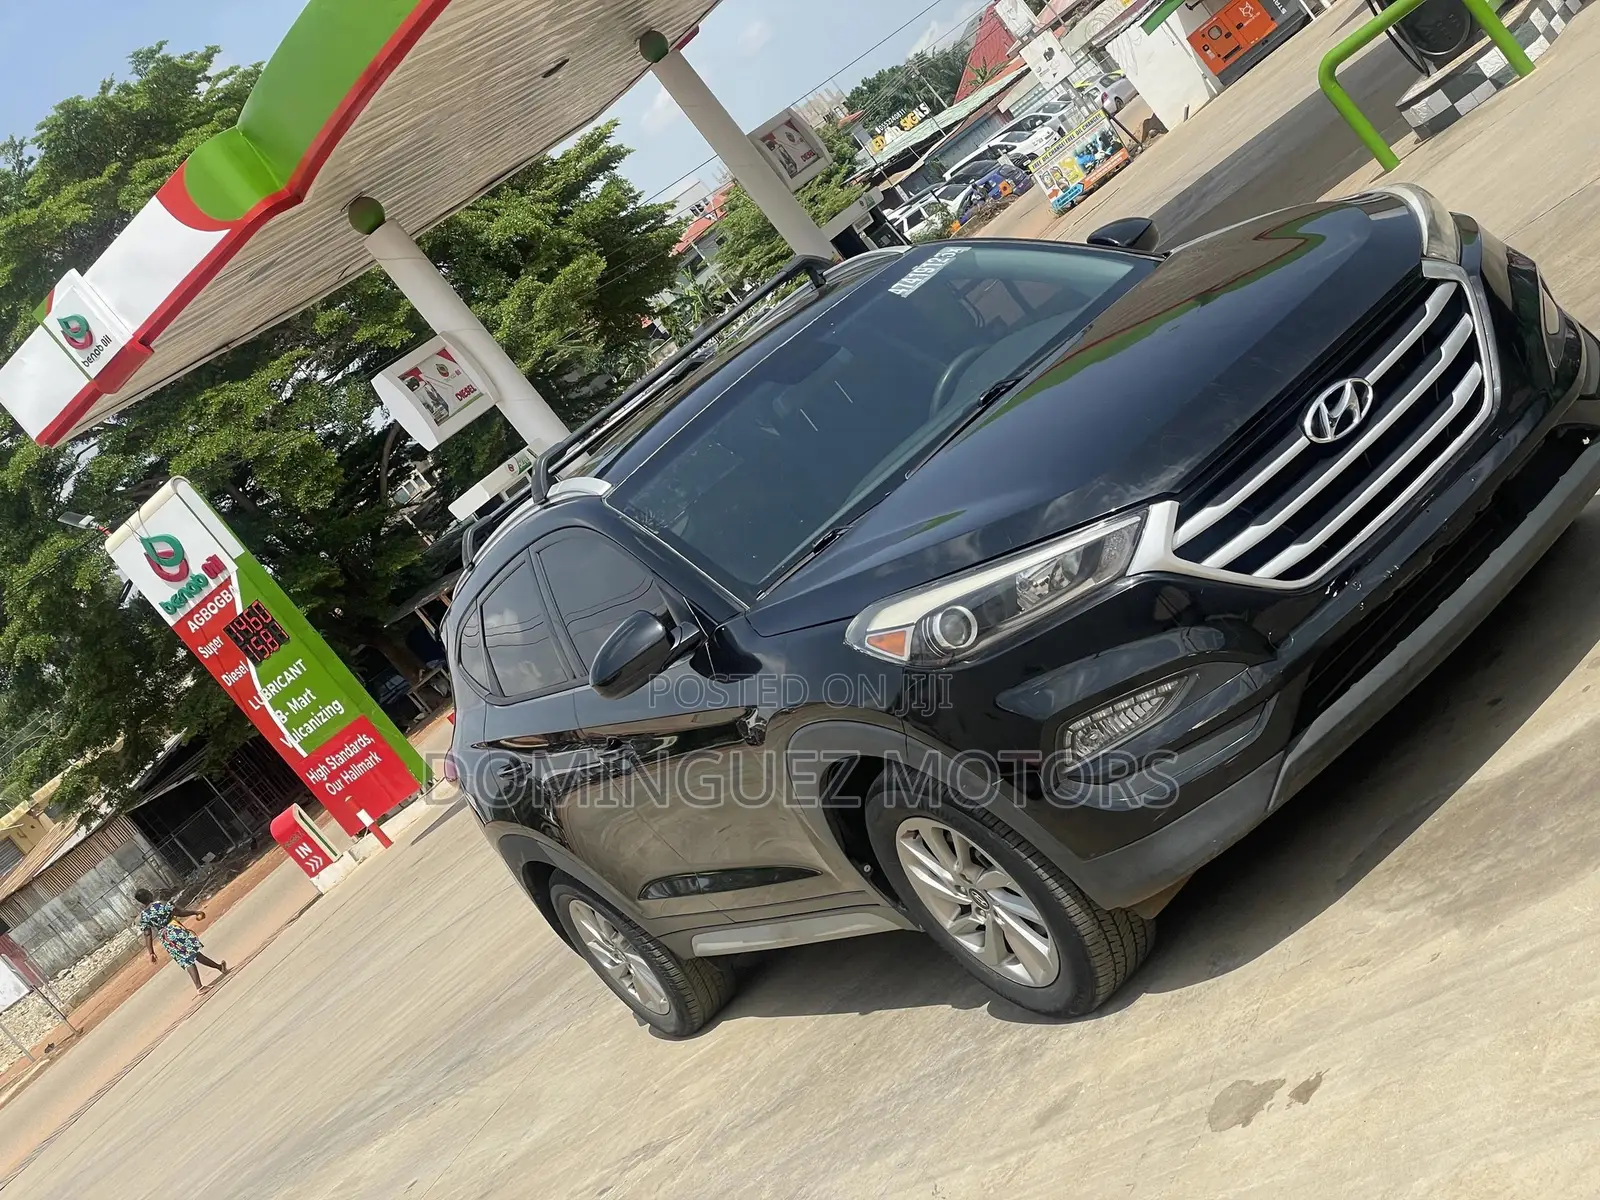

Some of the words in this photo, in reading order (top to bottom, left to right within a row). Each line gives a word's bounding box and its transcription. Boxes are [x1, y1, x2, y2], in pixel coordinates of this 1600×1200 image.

[900, 102, 931, 131] SIGNS
[455, 384, 477, 401] DIESEL
[198, 636, 224, 659] Super
[221, 660, 249, 687] Diesel
[248, 659, 307, 710] LUBRICANT
[286, 688, 316, 715] Mart
[280, 699, 345, 748] Vulcanizing
[305, 764, 330, 785] High
[325, 733, 375, 770] Standards,
[325, 779, 345, 796] Our
[343, 752, 382, 785] Hallmark
[295, 842, 312, 859] IN
